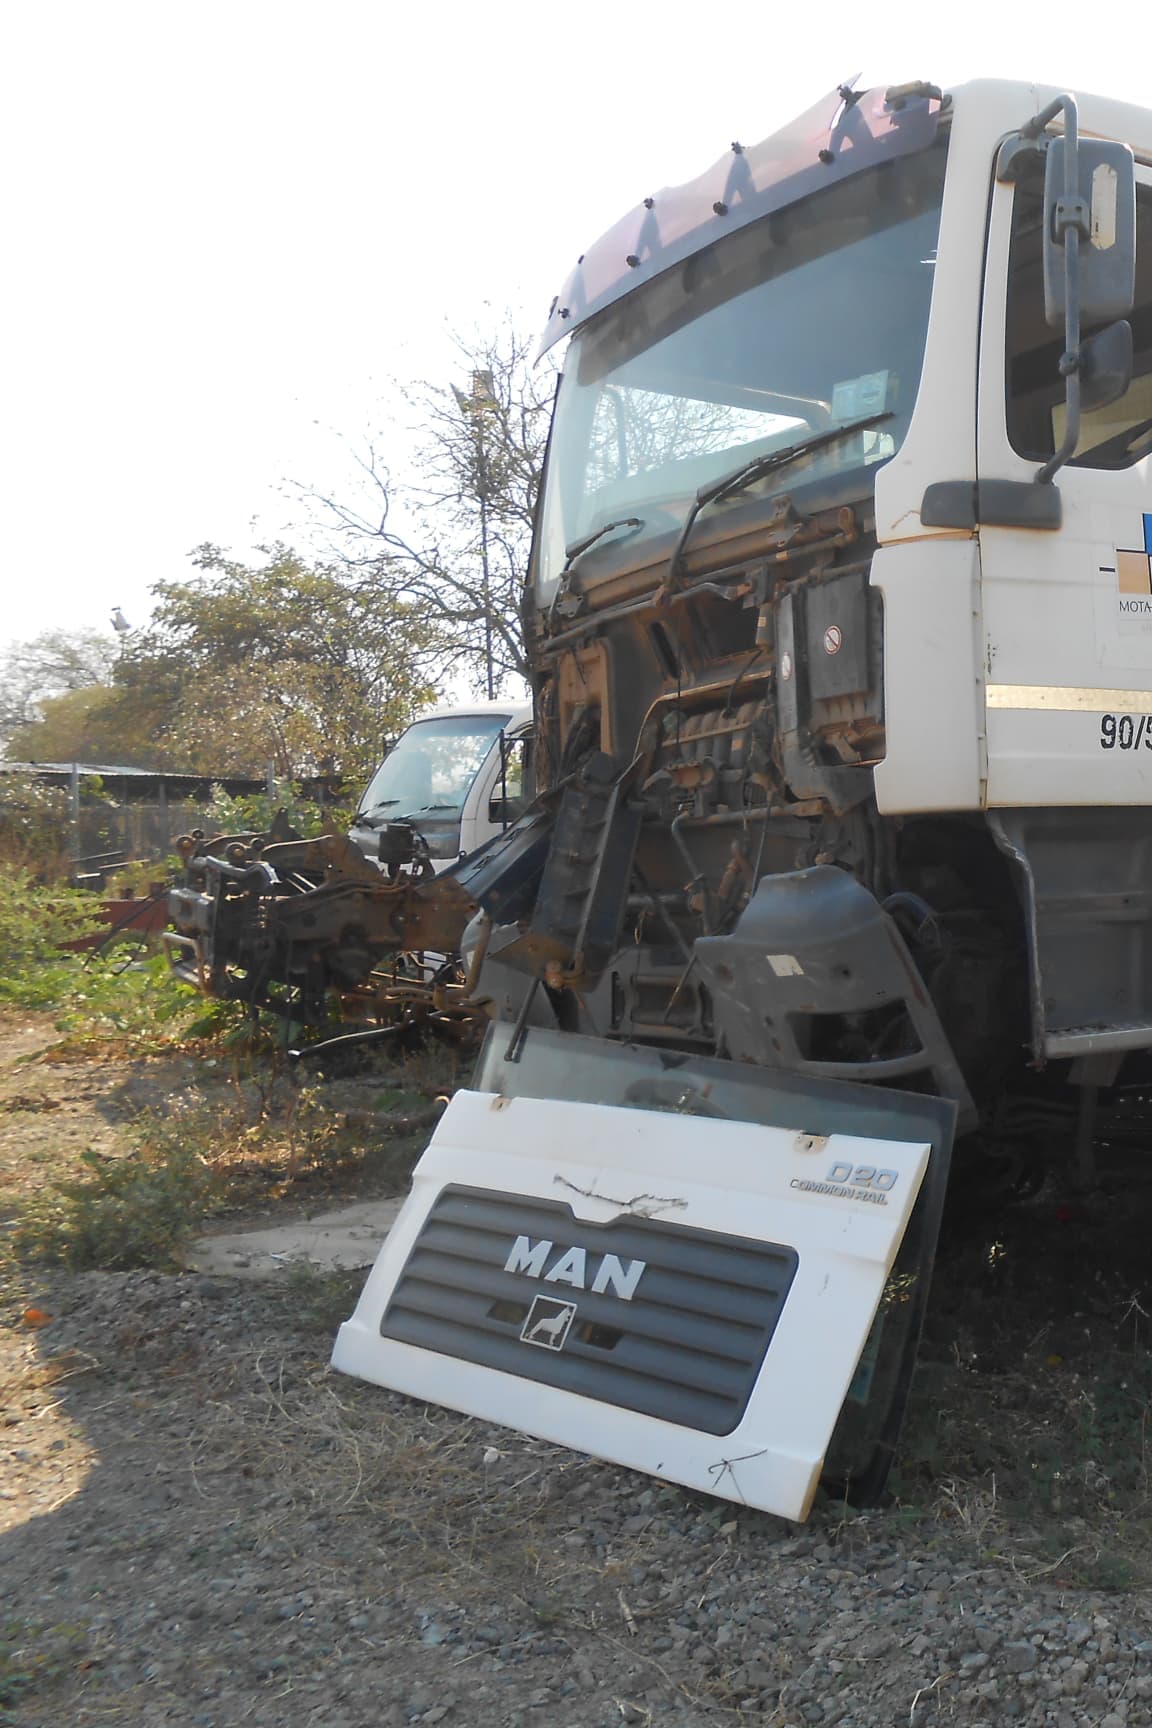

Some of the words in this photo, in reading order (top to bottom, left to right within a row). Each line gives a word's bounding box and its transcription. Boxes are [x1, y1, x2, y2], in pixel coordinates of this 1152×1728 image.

[825, 1161, 899, 1191] D20
[790, 1178, 855, 1199] COMMON
[855, 1191, 888, 1206] RAIL
[503, 1235, 646, 1301] MAN
